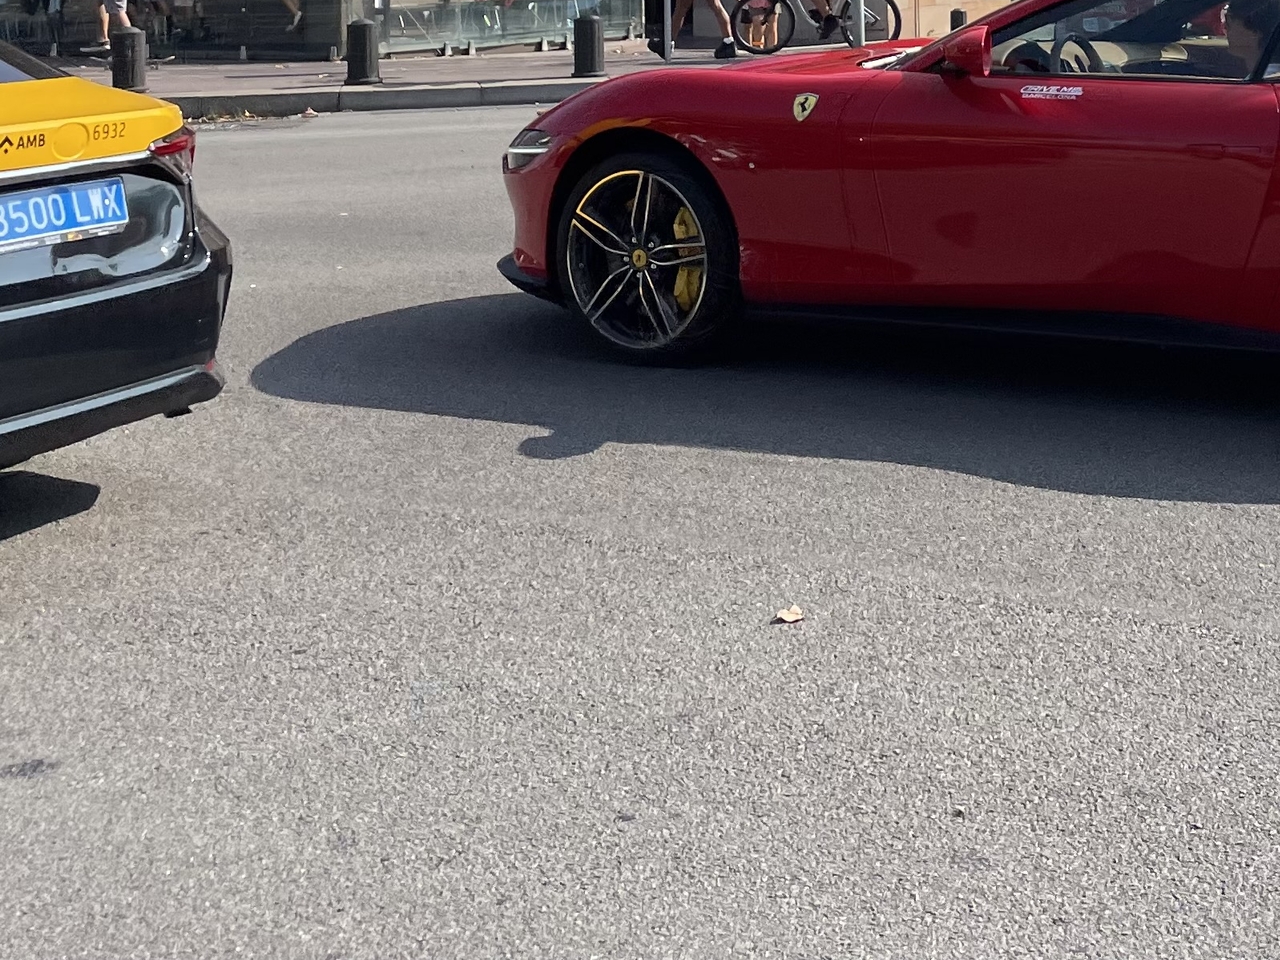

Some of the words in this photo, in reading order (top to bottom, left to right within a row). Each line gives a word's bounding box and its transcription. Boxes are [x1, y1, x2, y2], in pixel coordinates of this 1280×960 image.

[93, 122, 126, 140] 6932
[16, 134, 46, 150] AMB
[71, 184, 122, 223] LWX
